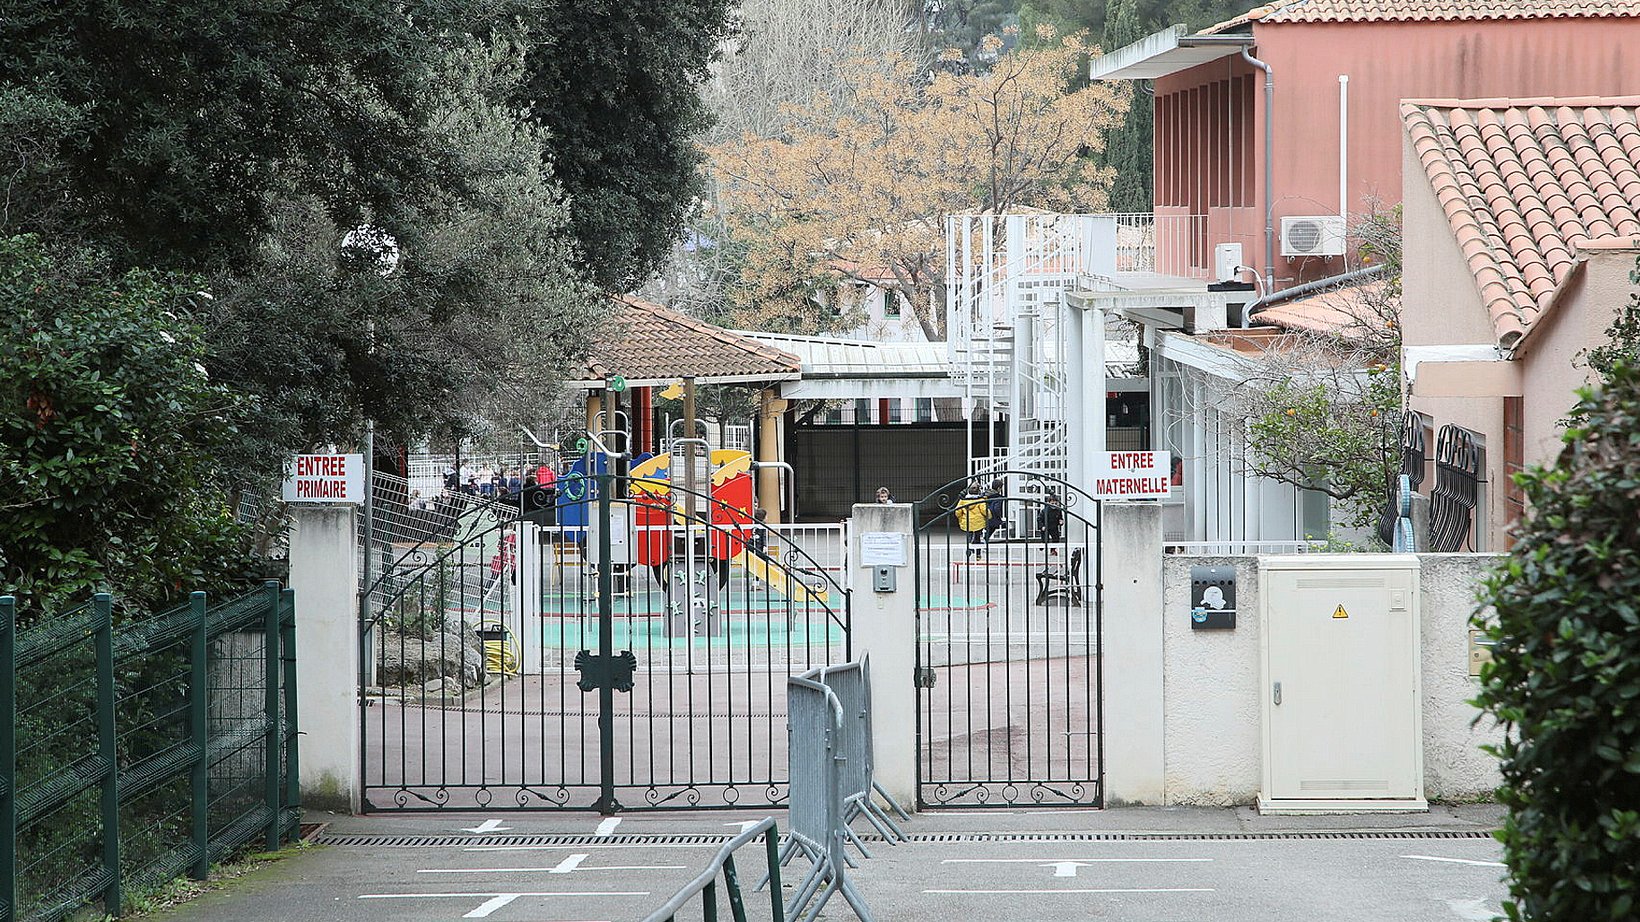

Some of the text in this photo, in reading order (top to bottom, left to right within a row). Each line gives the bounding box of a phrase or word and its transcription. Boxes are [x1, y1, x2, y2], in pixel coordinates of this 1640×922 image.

[297, 456, 346, 476] ENTREE
[1111, 452, 1154, 470] ENTREE
[297, 480, 347, 498] PRIMAIRE
[1096, 477, 1168, 495] MATERNELLE
